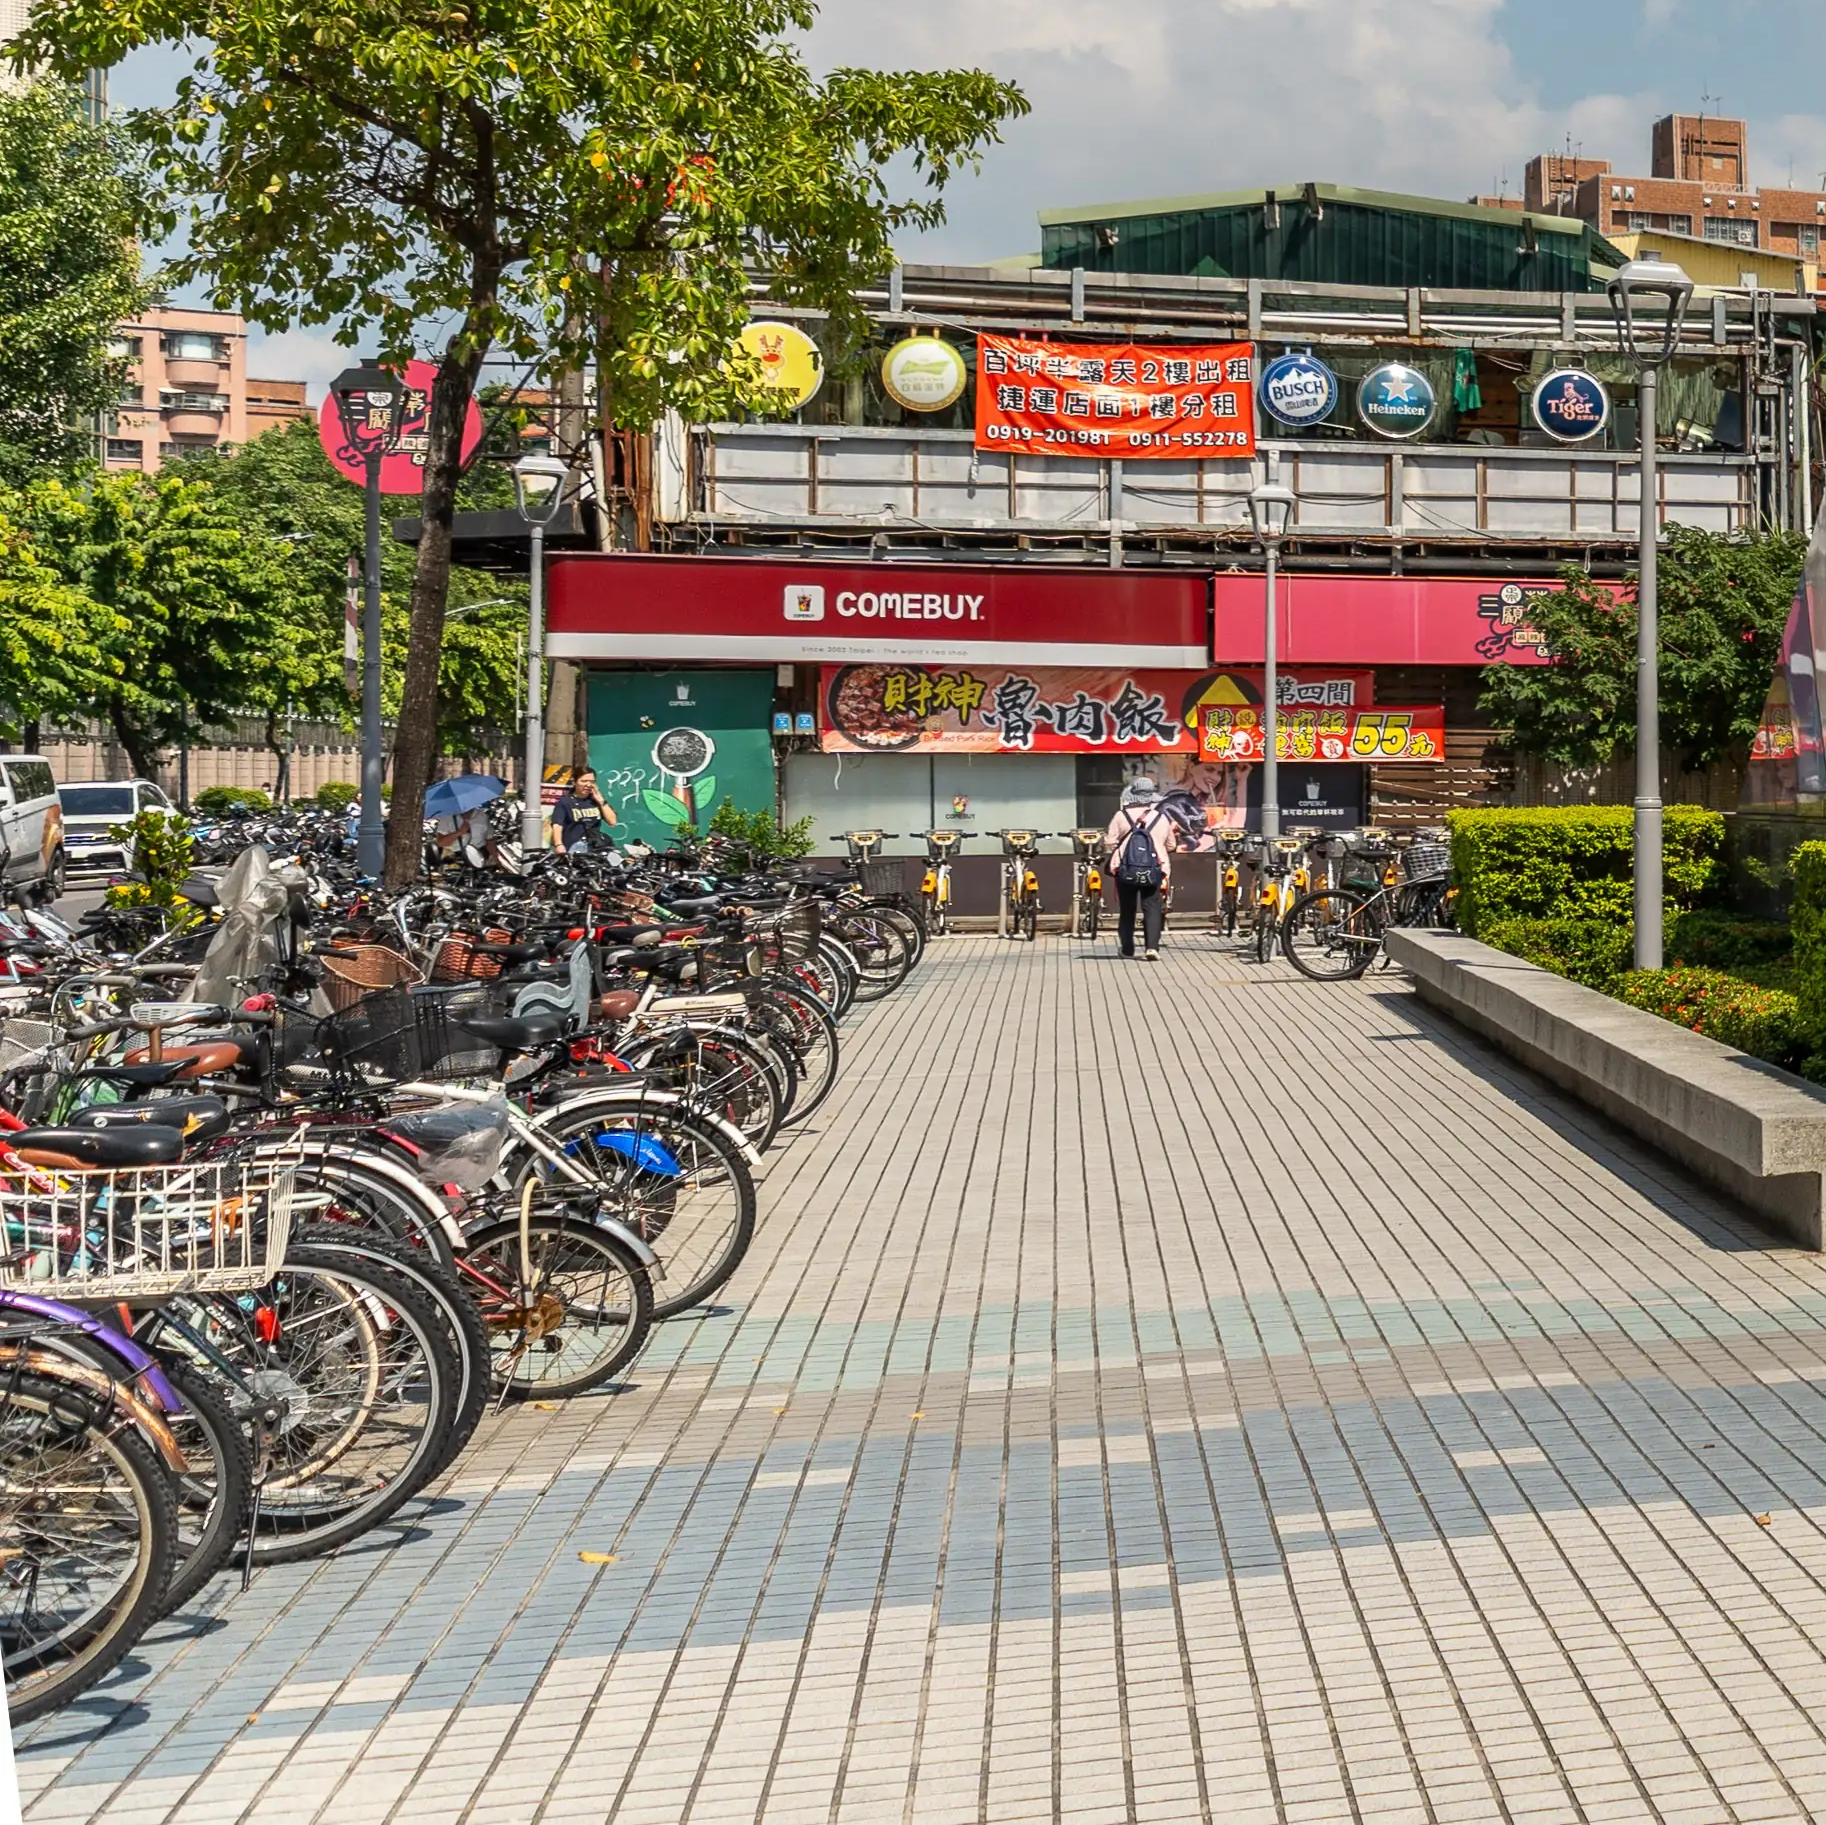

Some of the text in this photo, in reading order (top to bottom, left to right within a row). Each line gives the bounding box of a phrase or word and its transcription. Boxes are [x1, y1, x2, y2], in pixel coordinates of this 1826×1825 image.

[984, 348, 1251, 385] 百坪半露天2樓出租
[998, 385, 1237, 418] 捷運店面1樓分租
[1272, 380, 1325, 400] BUSCH
[1368, 403, 1426, 416] Heineken
[1547, 398, 1594, 420] Tiger
[1129, 431, 1248, 447] 0911-552278
[836, 591, 985, 620] COMEBUY
[884, 672, 987, 725] 財神
[1275, 676, 1355, 706] 第四間
[1353, 713, 1434, 756] 55 元
